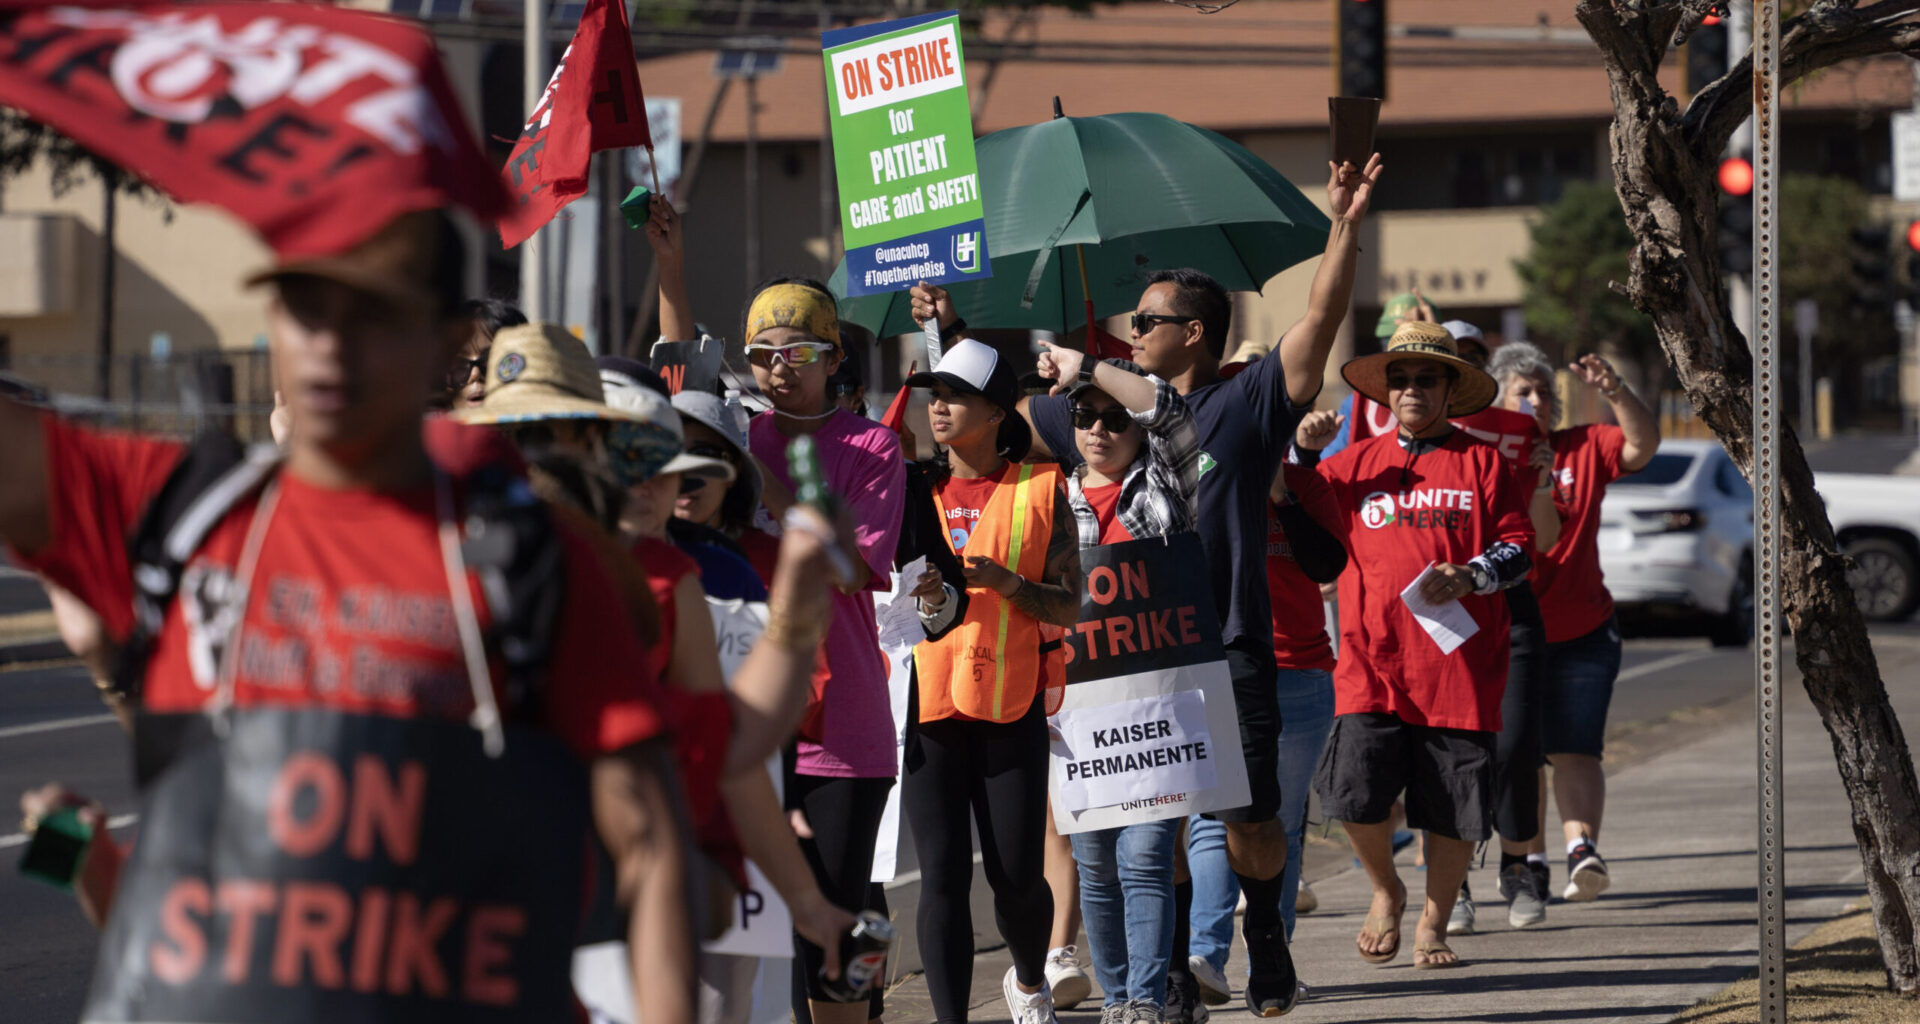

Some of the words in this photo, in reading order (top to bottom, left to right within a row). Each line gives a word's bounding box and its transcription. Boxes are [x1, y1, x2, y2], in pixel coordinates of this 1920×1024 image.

[842, 58, 873, 100] ON
[877, 37, 954, 91] STRIKE
[889, 108, 914, 135] for
[870, 134, 948, 184] PATIENT
[849, 195, 891, 229] CARE
[892, 187, 925, 219] and
[926, 173, 978, 211] SAFETY
[875, 243, 929, 264] @unacuhcp
[864, 261, 946, 287] #TogetherWeRise
[946, 507, 980, 519] ISER
[1398, 488, 1473, 511] UNITE
[1397, 509, 1471, 531] HERE!
[1088, 560, 1150, 606] ON
[973, 663, 985, 682] 5
[1093, 720, 1171, 748] KAISER
[1066, 742, 1207, 781] PERMANENTE
[268, 752, 426, 865] ON
[149, 877, 527, 1005] STRIKE
